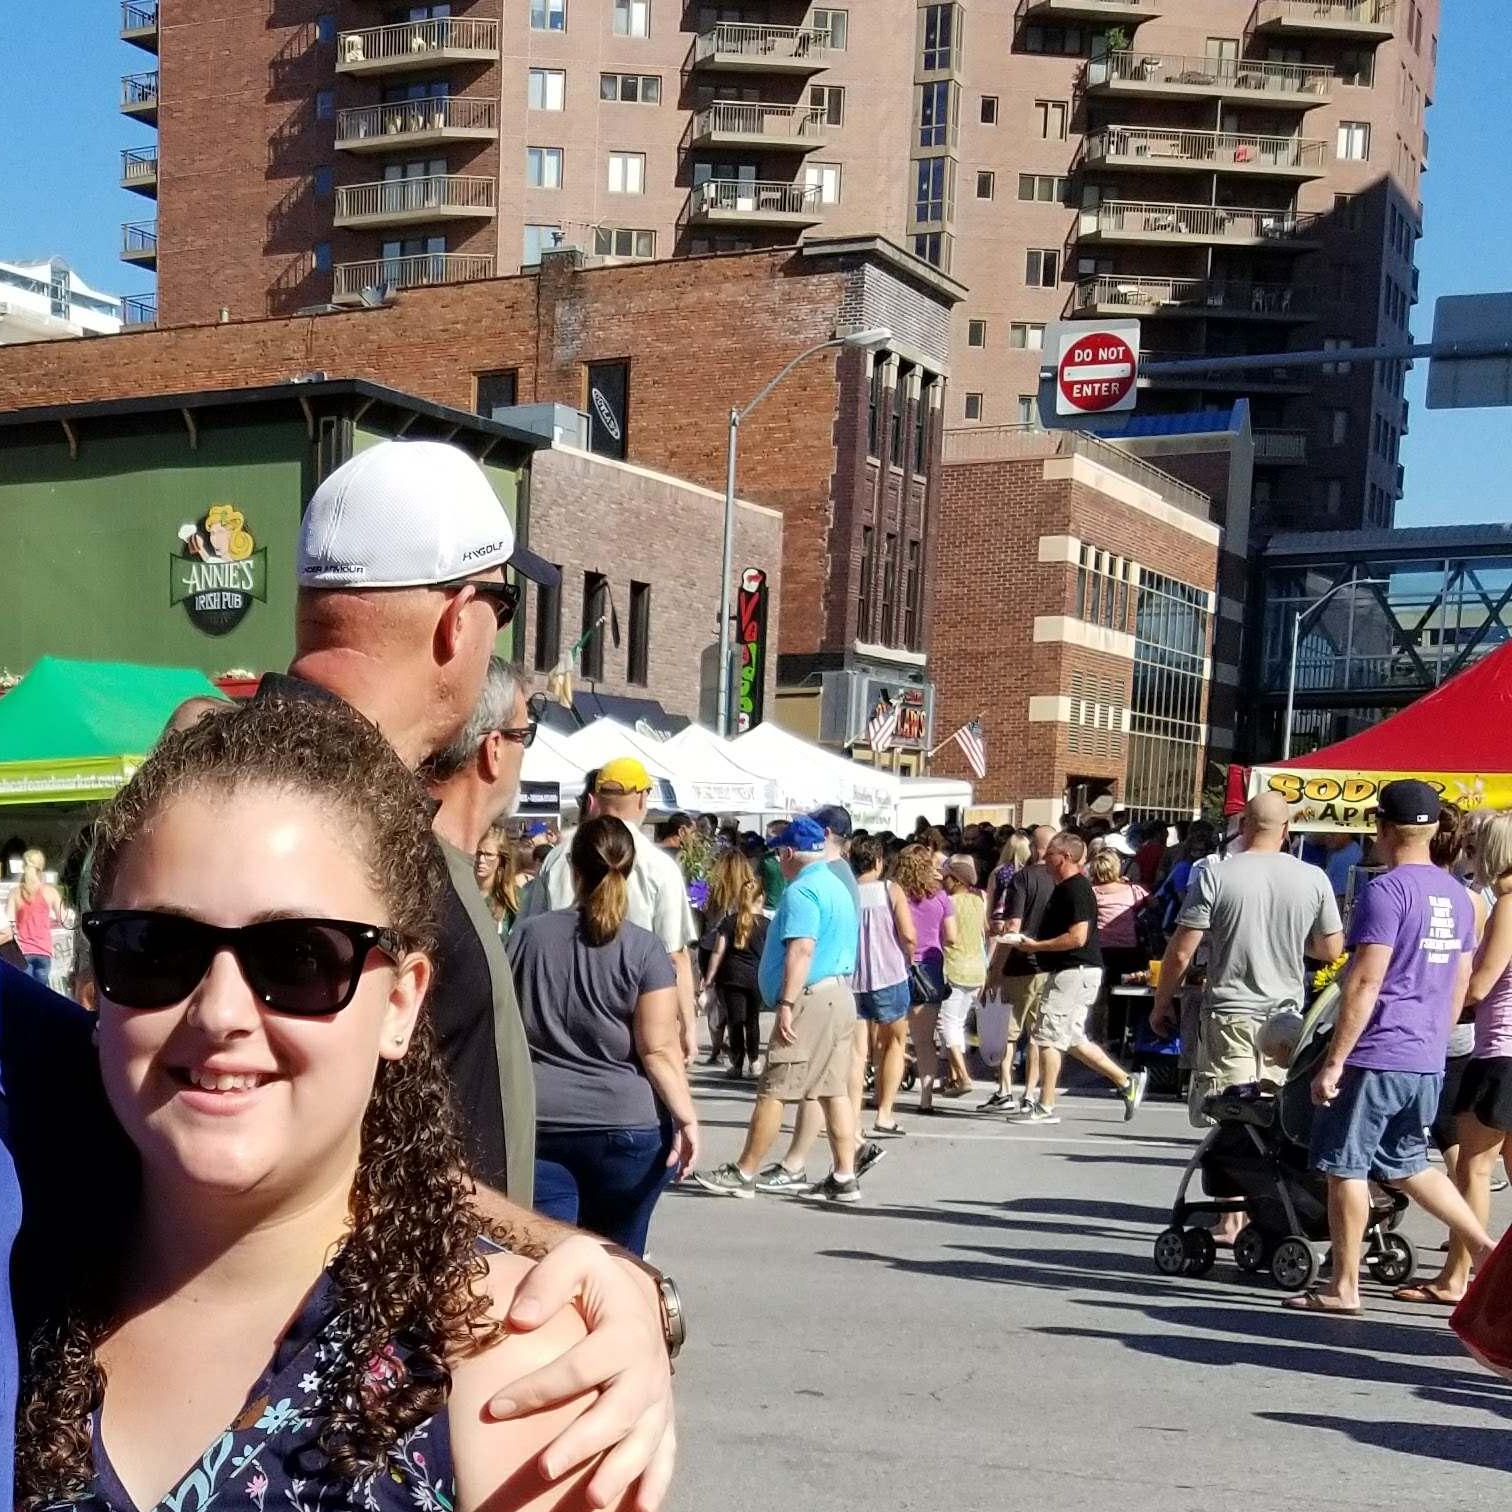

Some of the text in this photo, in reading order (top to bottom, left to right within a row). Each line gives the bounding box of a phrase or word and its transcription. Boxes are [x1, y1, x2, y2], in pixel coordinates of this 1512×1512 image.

[1074, 346, 1125, 362] DO NOT
[1073, 382, 1120, 398] ENTER
[195, 591, 242, 611] IRISH PUB
